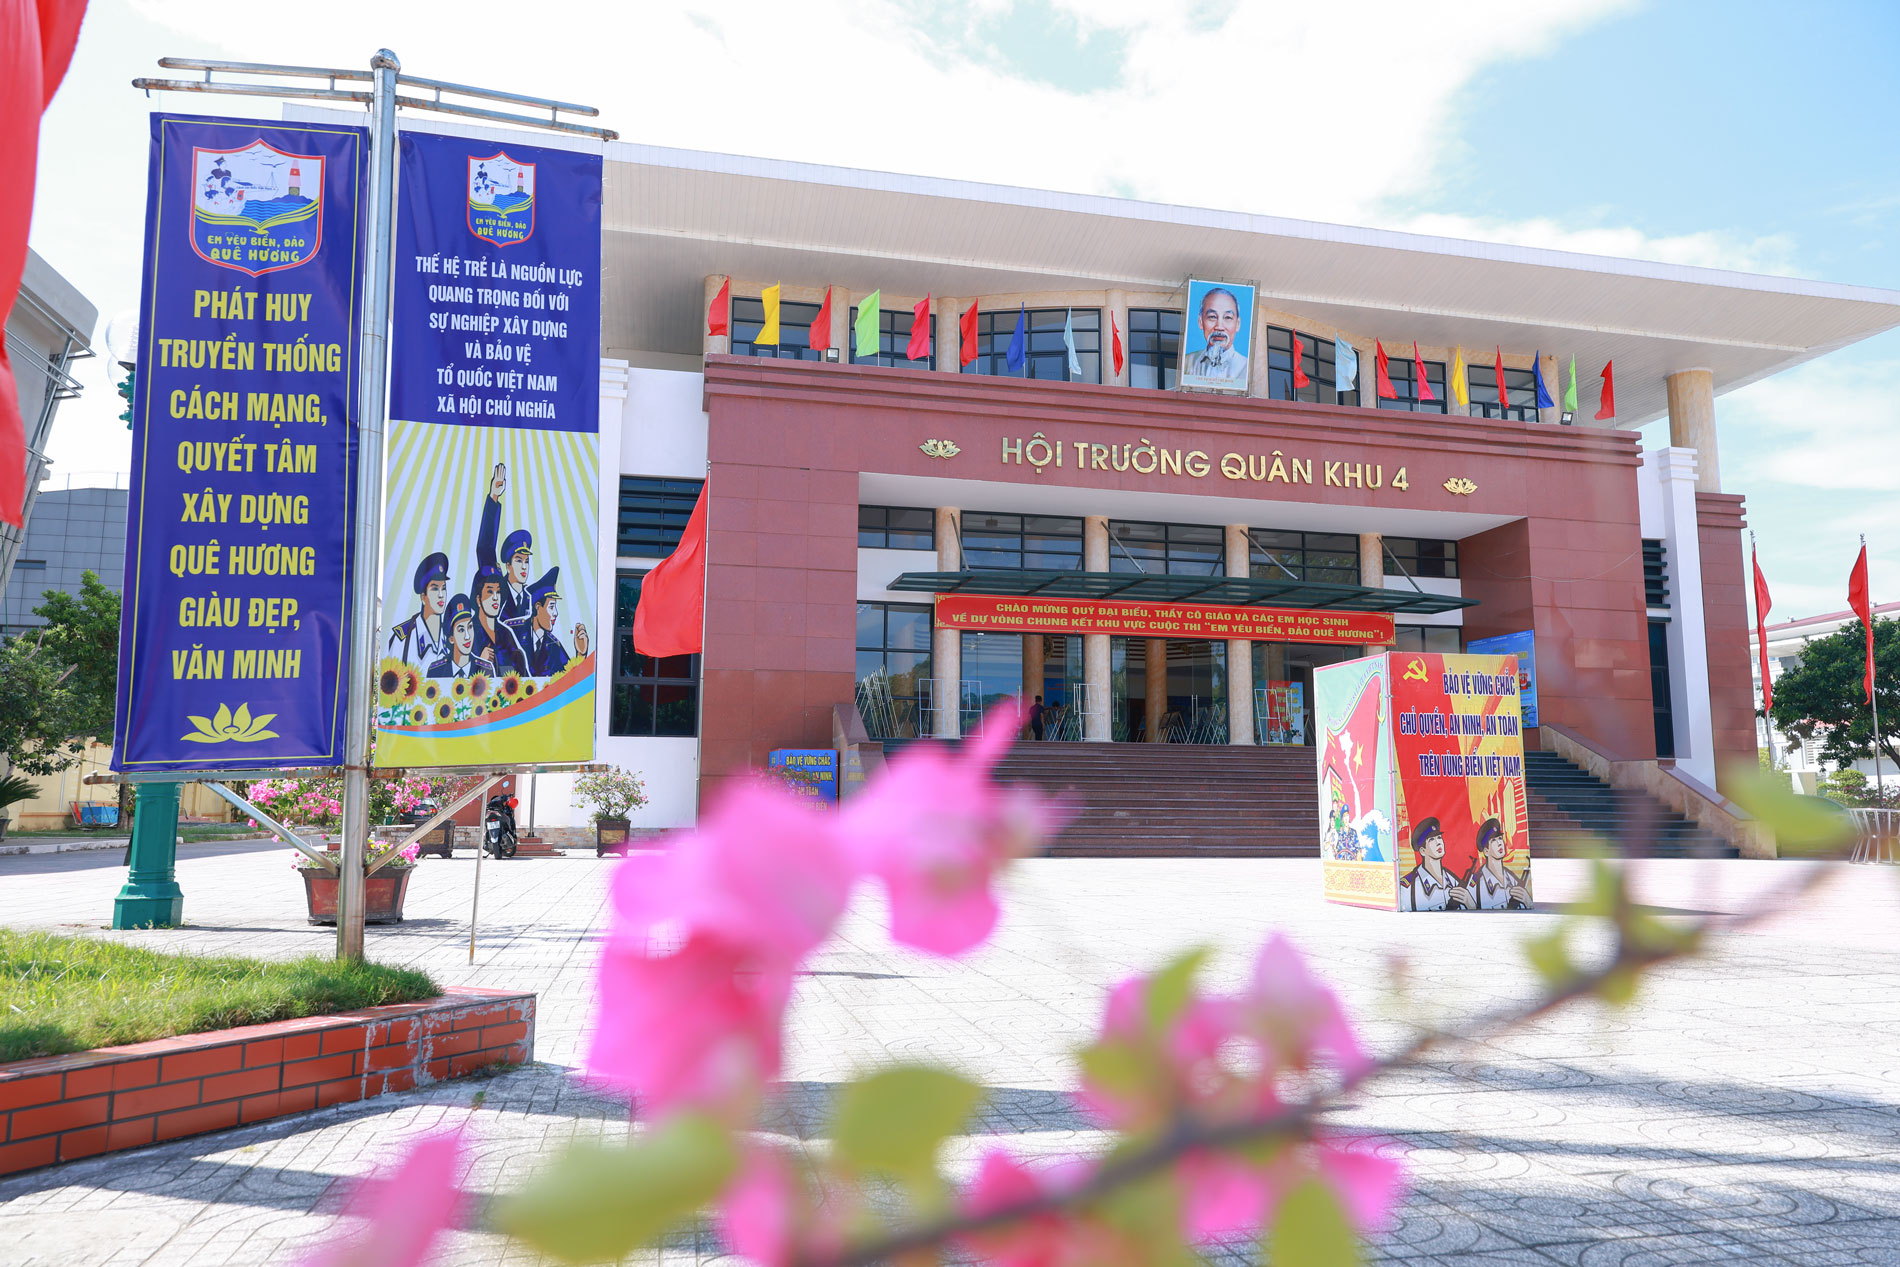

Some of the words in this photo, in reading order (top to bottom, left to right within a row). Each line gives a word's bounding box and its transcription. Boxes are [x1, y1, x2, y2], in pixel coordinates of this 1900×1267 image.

[208, 235, 222, 245] EM
[226, 234, 247, 246] YÊU
[250, 231, 280, 248] BIỂN,
[284, 235, 305, 248] ĐẢO
[211, 247, 242, 260] QUÊ
[249, 248, 300, 262] HƯƠNG
[416, 252, 440, 273] THẾ
[443, 256, 460, 278] HỆ
[464, 256, 487, 277] TRẺ
[492, 258, 507, 278] LÀ
[511, 262, 555, 283] NGUỒN
[560, 269, 582, 288] LỰC
[194, 286, 258, 320] PHÁT
[266, 293, 312, 322] HUY
[429, 285, 473, 303] QUANG
[477, 288, 519, 309] TRỌNG
[523, 289, 544, 310] ĐỐI
[549, 292, 568, 311] VỚI
[430, 313, 449, 332] SỰ
[451, 315, 499, 335] NGHIỆP
[503, 316, 528, 335] XÂY
[532, 320, 567, 340] DỰNG
[159, 333, 254, 370] TRUYỀN
[263, 334, 341, 372] THỐNG
[465, 340, 482, 359] VÀ
[486, 340, 512, 361] BẢO
[516, 344, 531, 365] VỆ
[437, 363, 454, 384] TỔ
[457, 364, 492, 388] QUỐC
[497, 370, 523, 392] VIỆT
[527, 375, 557, 392] NAM
[170, 384, 238, 420] CÁCH
[247, 392, 327, 428] MẠNG,
[437, 394, 455, 413] XÃ
[460, 396, 481, 418] HỘI
[486, 395, 511, 416] CHỦ
[516, 400, 555, 419] NGHĨA
[178, 434, 256, 473] QUYẾT
[264, 439, 317, 473] TÂM
[1002, 432, 1062, 474] HỘI
[1074, 438, 1211, 478] TRƯỜNG
[1221, 450, 1312, 484] QUÂN
[1325, 460, 1382, 489] KHU
[1392, 467, 1409, 490] 4
[181, 488, 232, 523] XÂY
[240, 492, 308, 530] DỰNG
[170, 540, 219, 578] QUÊ
[229, 543, 315, 576] HƯƠNG
[179, 591, 240, 627] GIÀU
[248, 597, 300, 633] ĐẸP,
[971, 614, 987, 624] DỰ
[1027, 617, 1068, 626] CHUNG
[1072, 615, 1093, 627] KẾT
[1097, 619, 1120, 628] KHU
[1124, 619, 1145, 629] VỰC
[1149, 620, 1179, 631] CUỘC
[1184, 622, 1200, 631] THI
[1232, 623, 1252, 633] YÊU
[1256, 623, 1284, 635] BIỂN,
[1288, 626, 1310, 636] ĐẢO
[1313, 627, 1334, 637] QUÊ
[996, 602, 1028, 613] CHÀO
[1032, 603, 1068, 614] MỪNG
[1072, 605, 1095, 615] QUÝ
[1098, 607, 1118, 616] ĐẠI
[1187, 610, 1201, 619] CÔ
[1205, 611, 1231, 621] GIÁO
[1235, 612, 1249, 622] VÀ
[1252, 613, 1274, 623] CÁC
[1277, 616, 1294, 624] EM
[1298, 616, 1319, 626] HỌC
[1323, 617, 1348, 626] SINH
[172, 644, 224, 679] VĂN
[232, 650, 301, 678] MINH
[1443, 667, 1459, 695] BẢO
[1461, 670, 1472, 699] VỆ
[1472, 671, 1494, 695] VỮNG
[1495, 668, 1516, 696] CHẮC
[1400, 706, 1417, 735] CHỦ
[1449, 714, 1460, 736] AN
[1462, 714, 1484, 738] NINH,
[1486, 714, 1497, 736] AN
[1498, 711, 1518, 736] TOÀN
[1419, 750, 1440, 776] TRÊN
[1442, 752, 1463, 776] VÙNG
[1465, 747, 1484, 776] BIỂN
[1486, 752, 1501, 780] VIỆT
